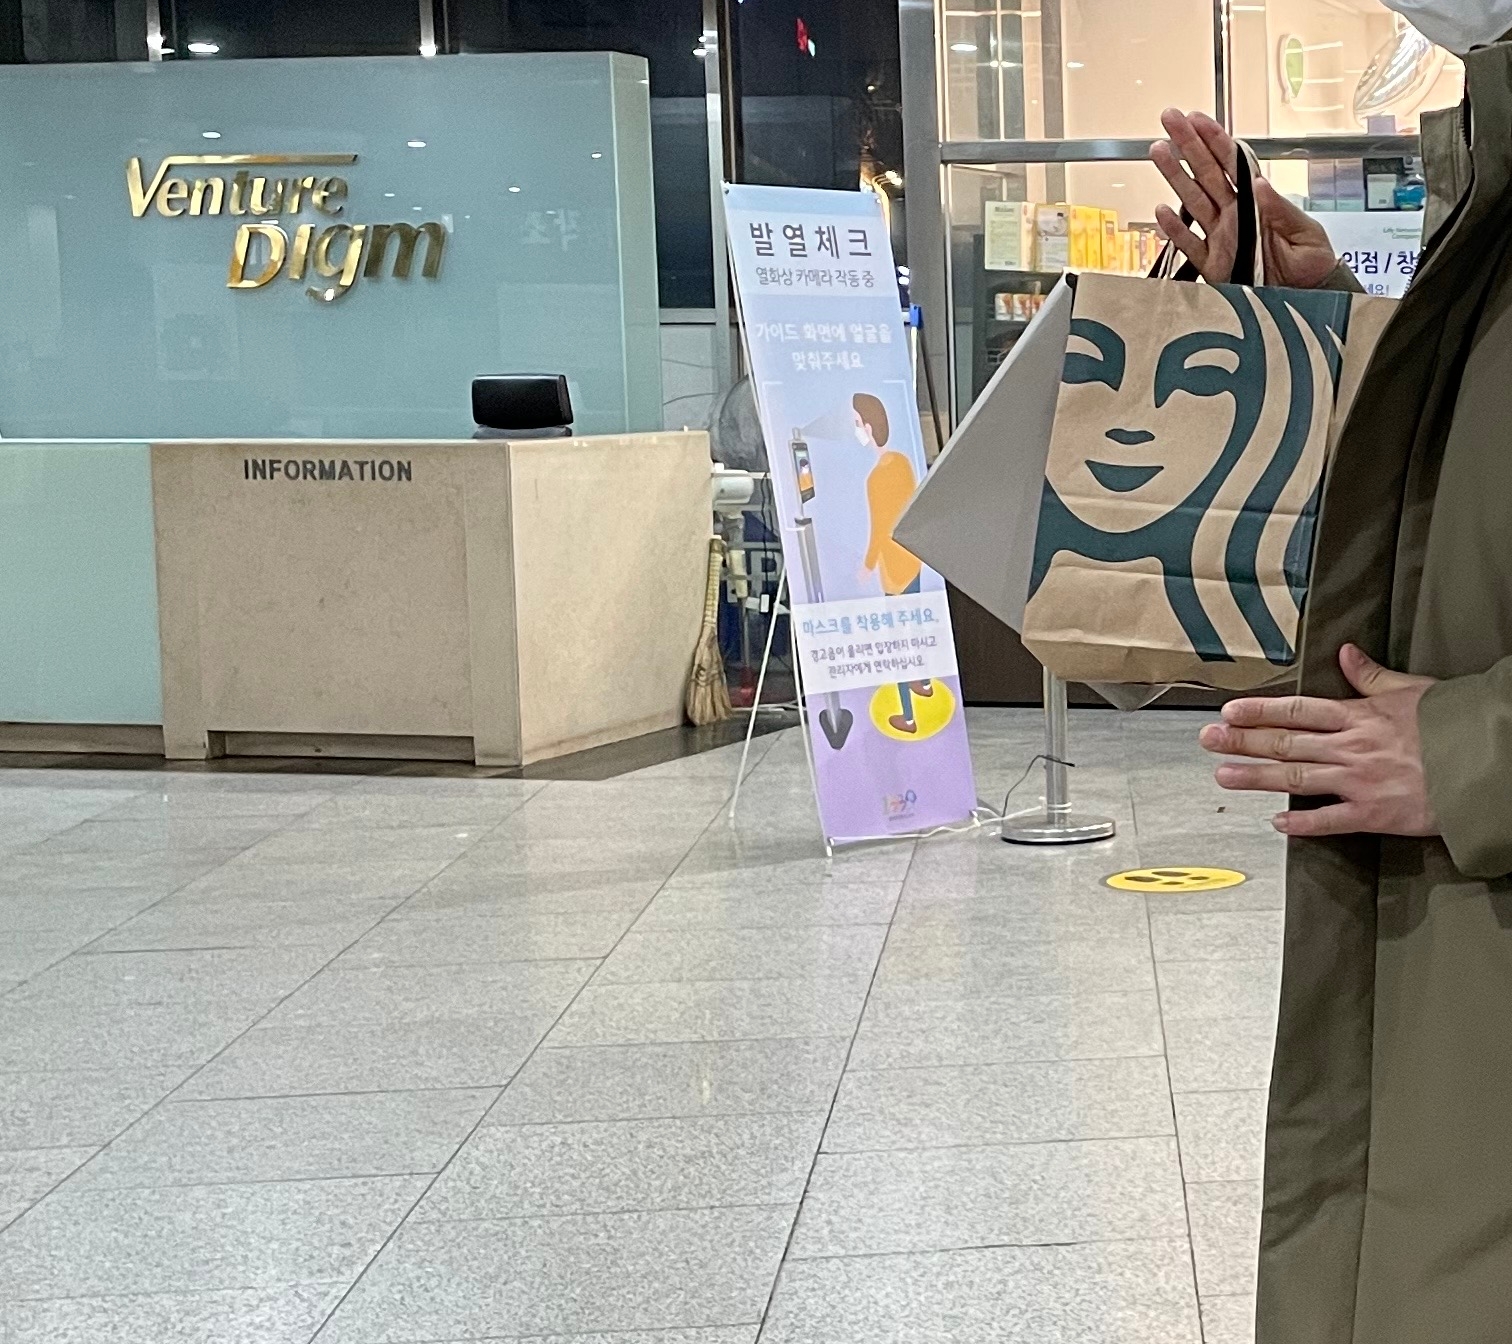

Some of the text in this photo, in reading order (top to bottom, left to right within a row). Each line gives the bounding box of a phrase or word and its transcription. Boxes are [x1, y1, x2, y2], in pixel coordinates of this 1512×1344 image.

[125, 154, 358, 217] Venture
[1342, 251, 1378, 274] 입점
[756, 267, 875, 288] 열화상 카메라 작동 중
[756, 323, 892, 344] 가이드 화면에 얼굴을
[244, 459, 412, 482] INFORMATION
[803, 616, 852, 636] 마스크를
[857, 612, 895, 632] 착용해
